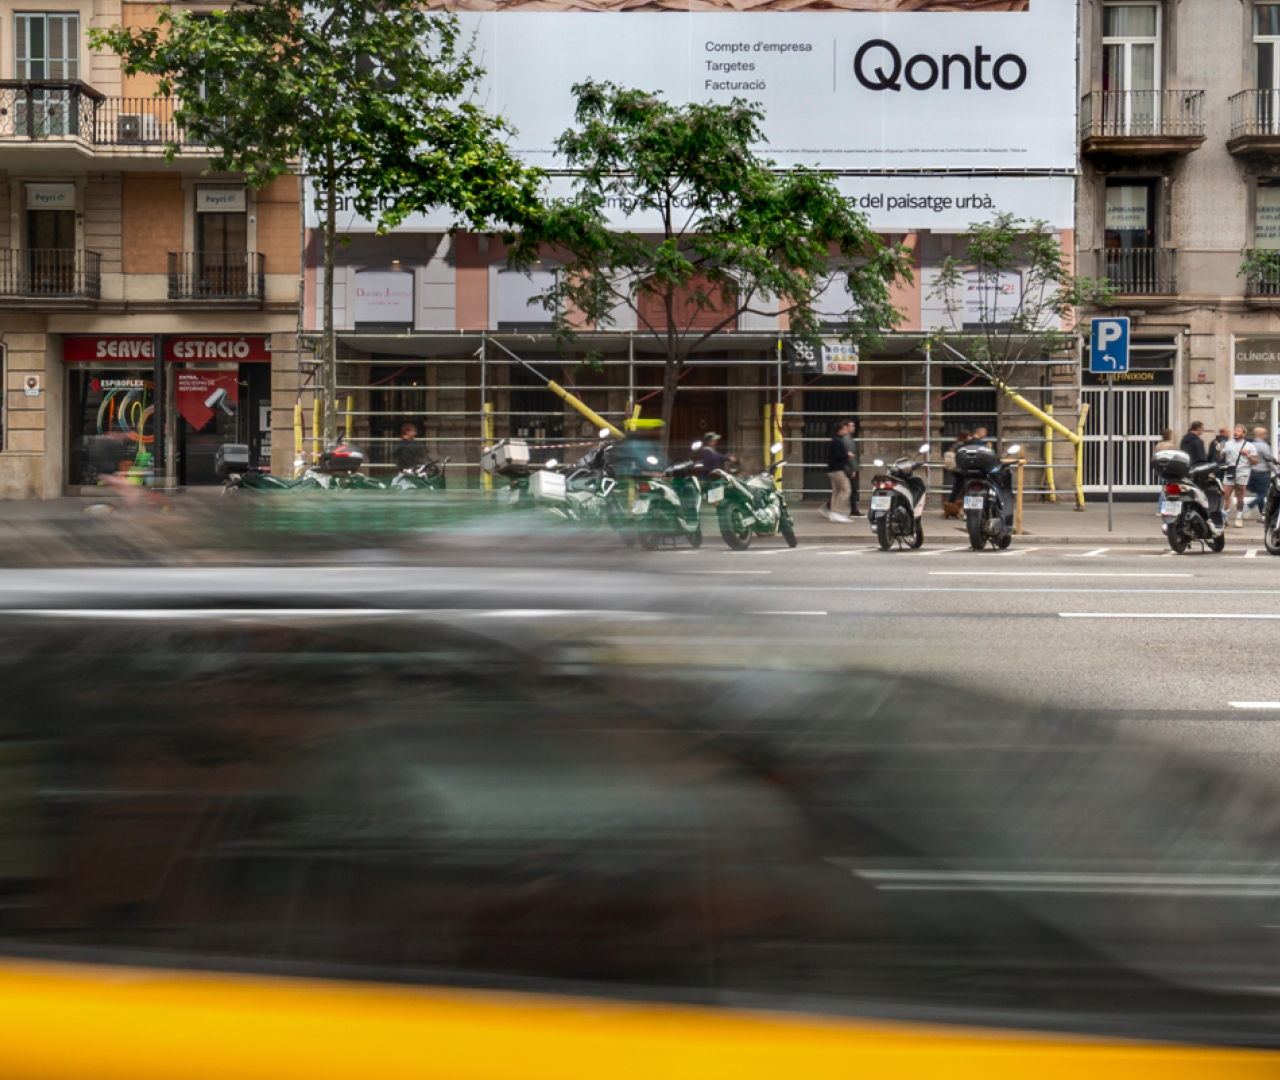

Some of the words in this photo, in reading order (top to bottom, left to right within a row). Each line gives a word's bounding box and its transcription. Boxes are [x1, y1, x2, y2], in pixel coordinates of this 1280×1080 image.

[705, 40, 751, 56] Compte
[753, 40, 813, 55] d'empresa
[705, 60, 755, 75] Targetes
[853, 38, 1028, 92] Qonto
[705, 78, 766, 91] Facturació
[860, 193, 884, 209] del
[886, 193, 952, 212] paisatge
[955, 193, 996, 209] urbà.
[1097, 321, 1123, 351] P
[173, 337, 250, 358] ESTACIÓ
[1236, 349, 1275, 362] CLÍNICA
